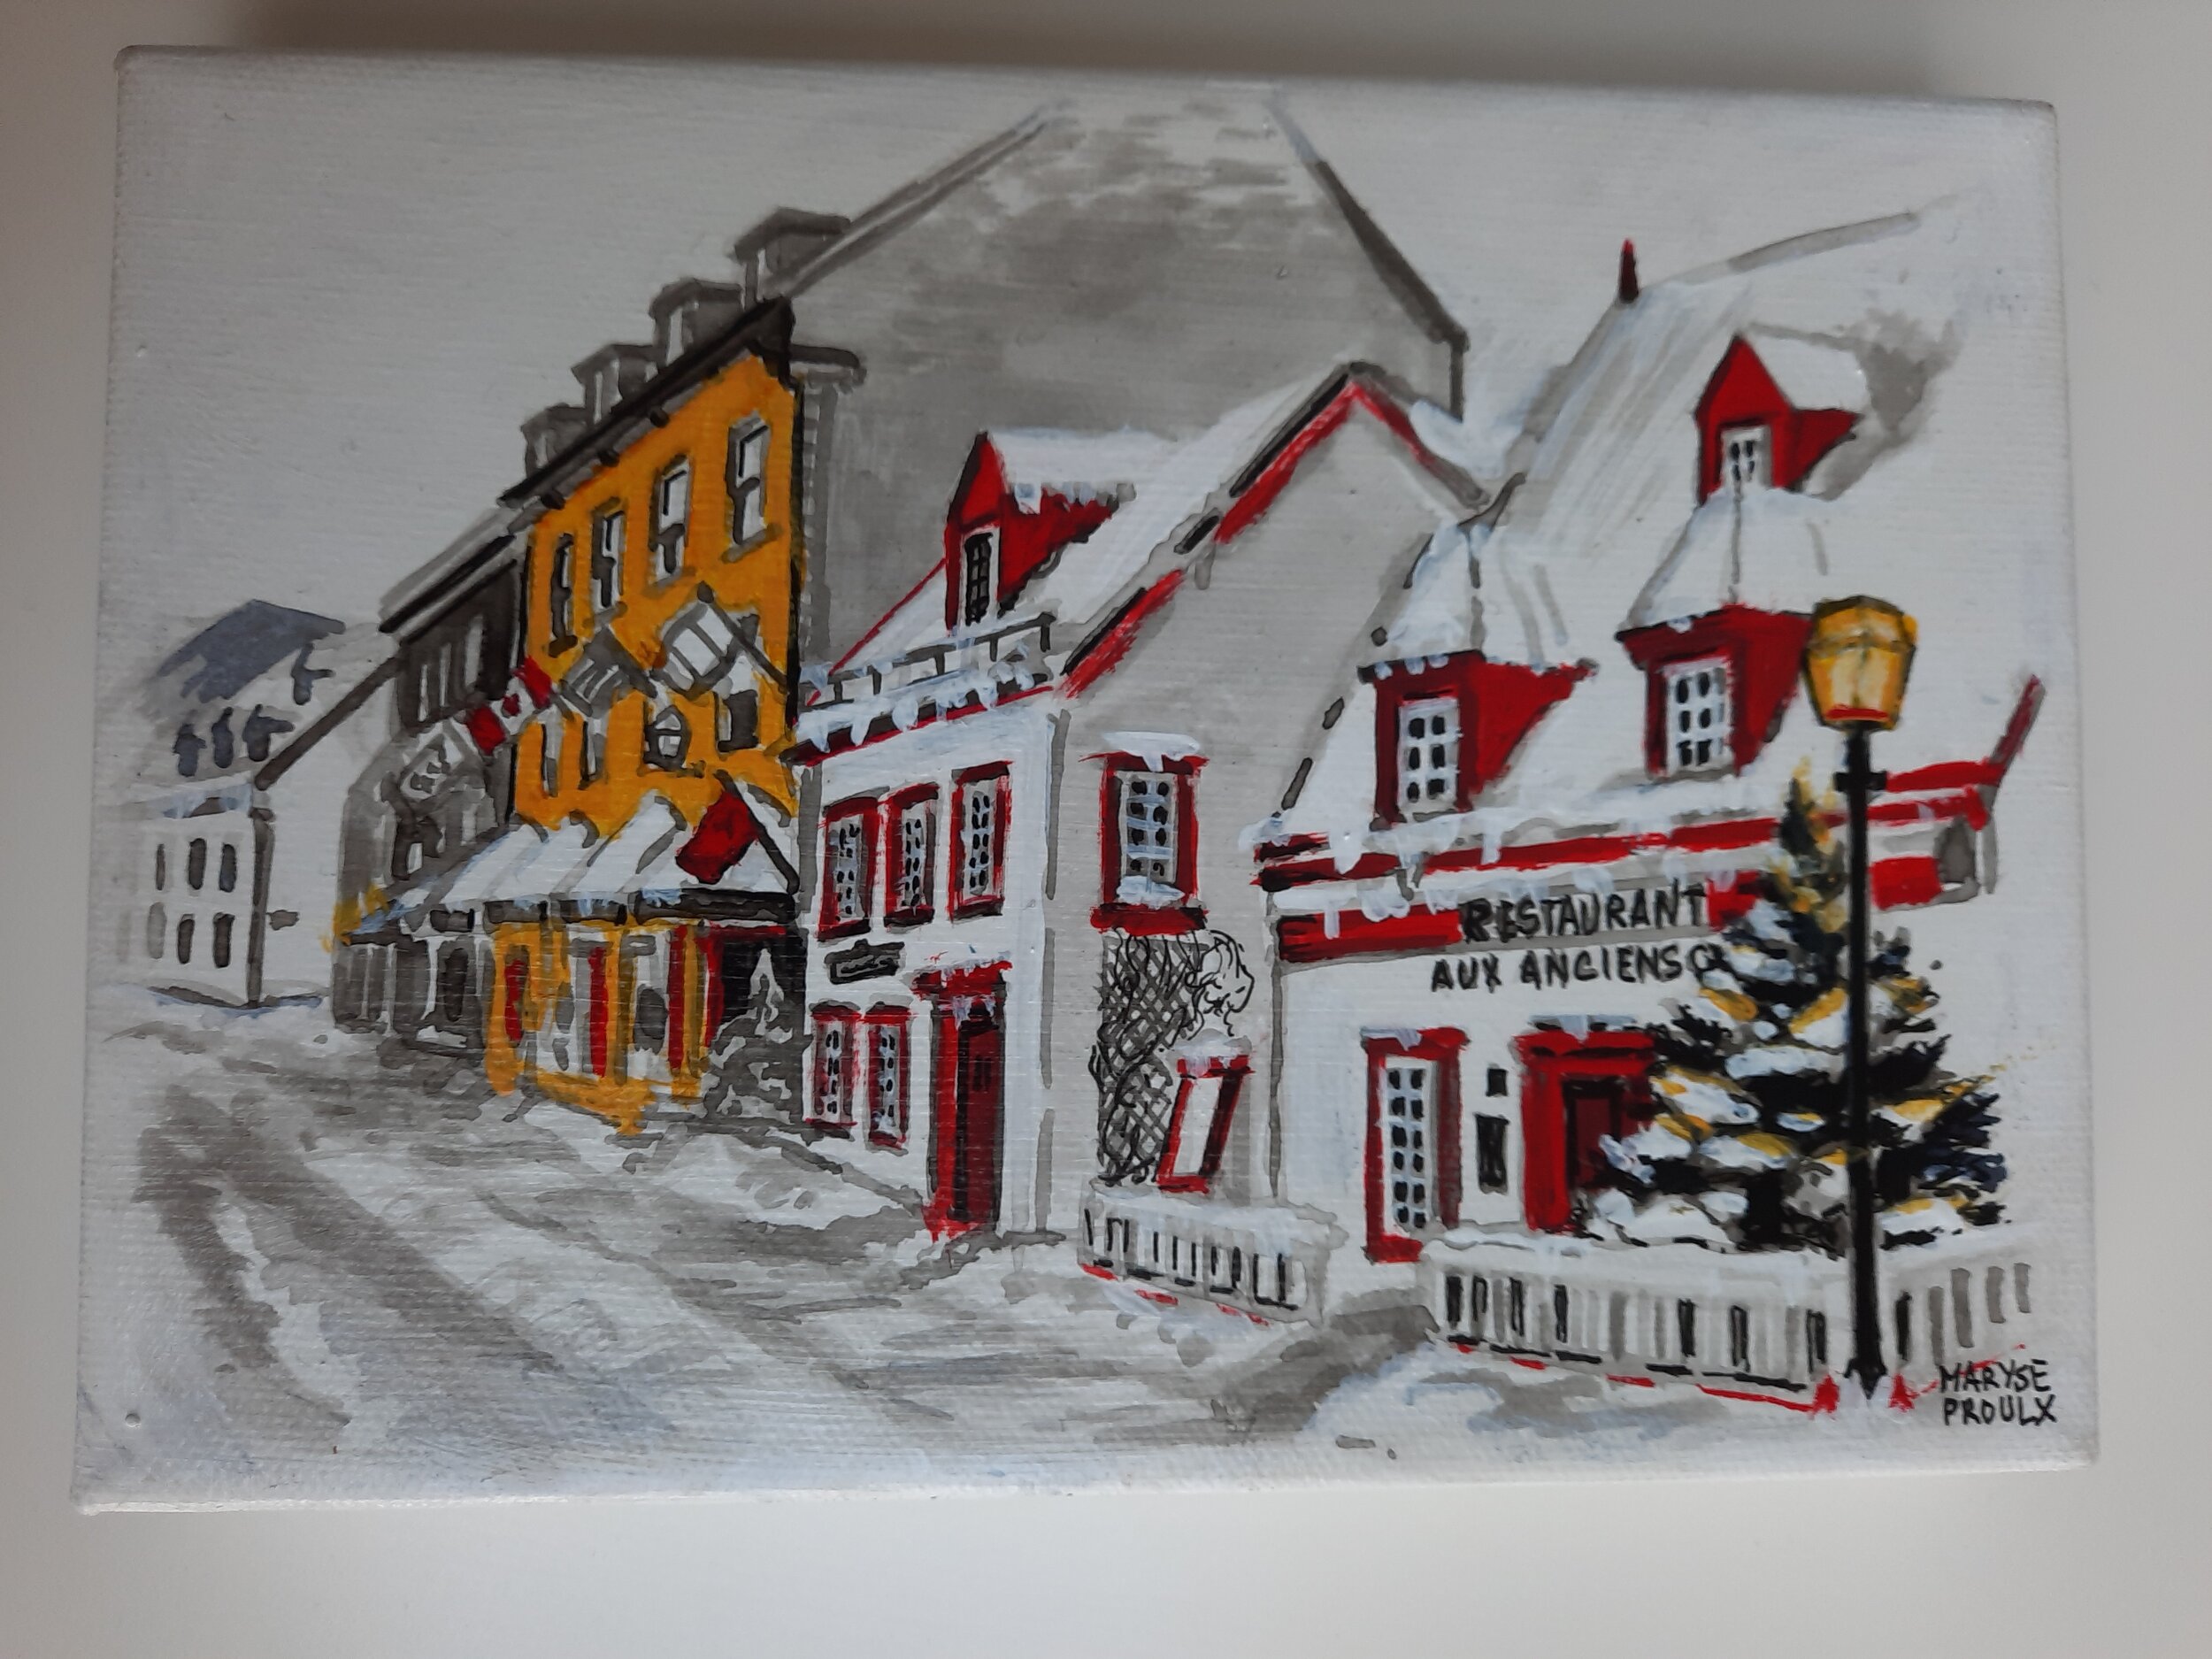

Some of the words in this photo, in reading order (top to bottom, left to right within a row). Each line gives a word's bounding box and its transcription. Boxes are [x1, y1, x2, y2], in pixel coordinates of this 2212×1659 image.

[1460, 879, 1706, 943] RESTAURANT
[1431, 954, 1502, 994] AUX
[1520, 944, 1683, 991] ANCIENS
[1939, 1359, 2051, 1393] MARYSE
[1944, 1394, 2057, 1426] PROULX
